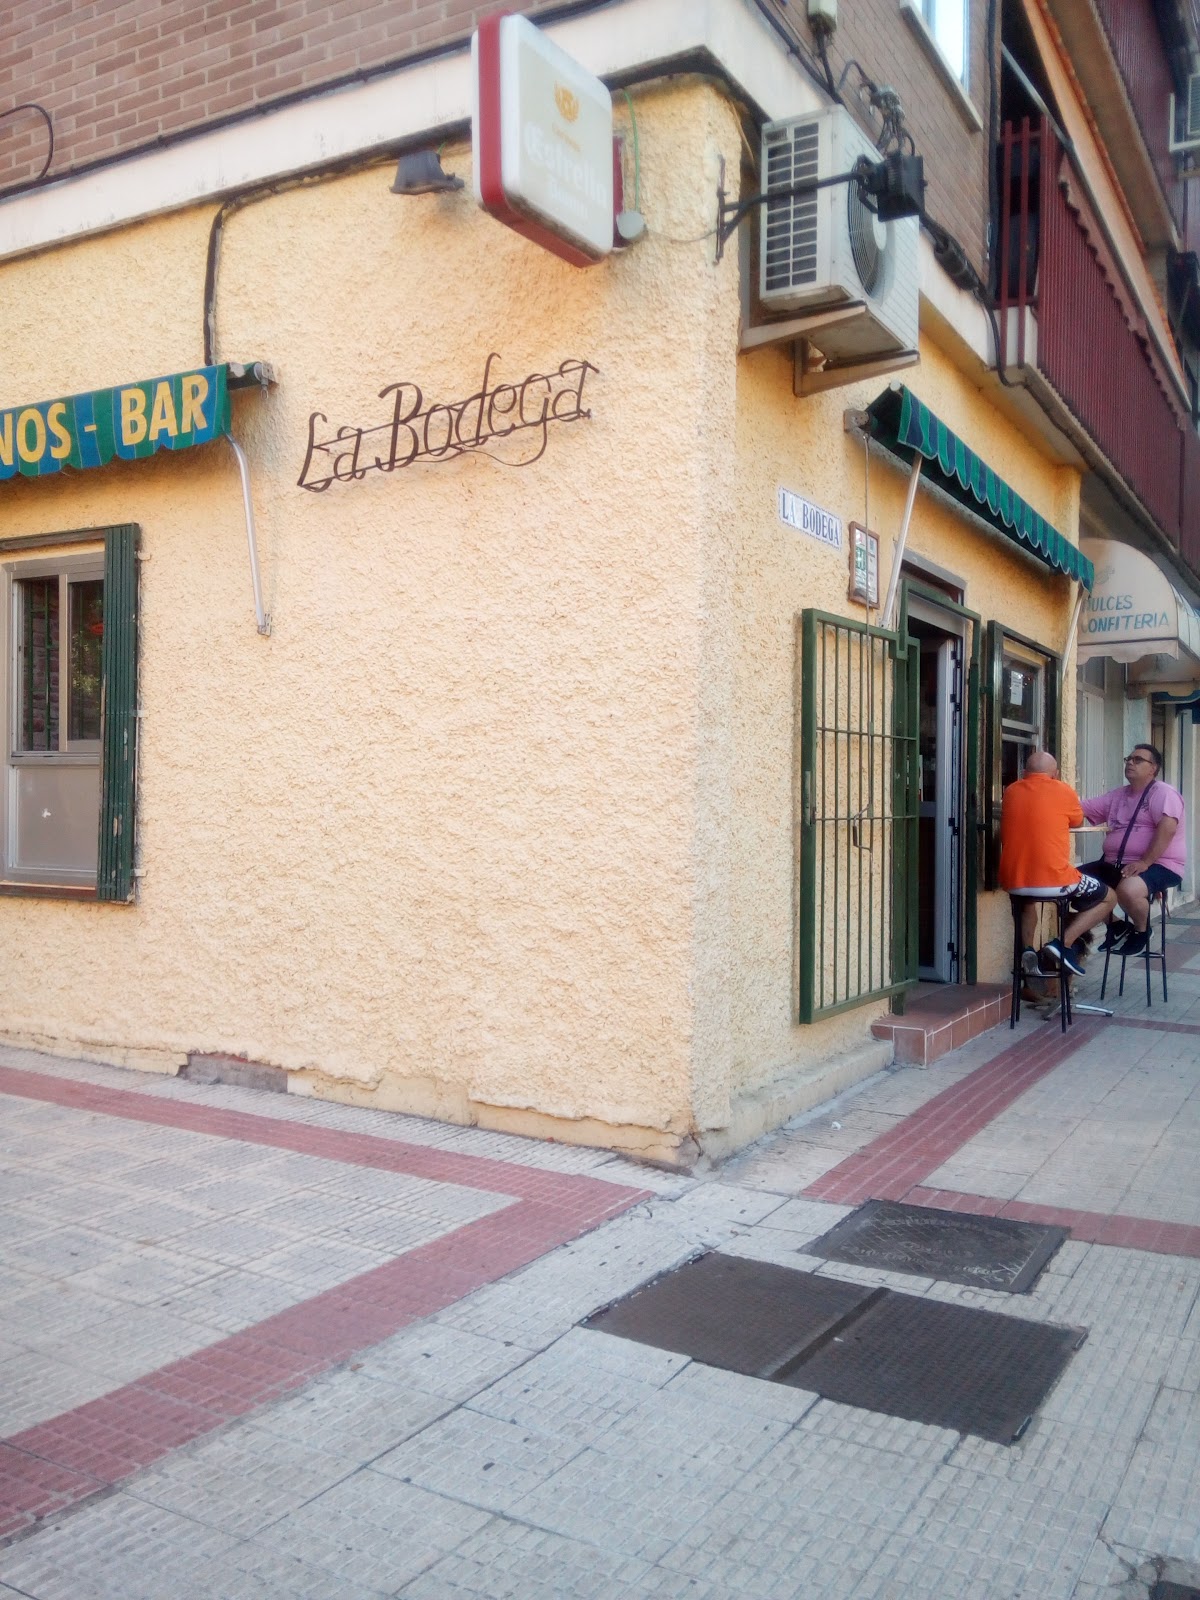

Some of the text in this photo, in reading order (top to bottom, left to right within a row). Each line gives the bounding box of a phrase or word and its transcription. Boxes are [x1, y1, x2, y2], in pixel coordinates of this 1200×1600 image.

[121, 374, 209, 446] BAR
[297, 352, 600, 493] La Bodega
[782, 492, 839, 545] LA BODEGA
